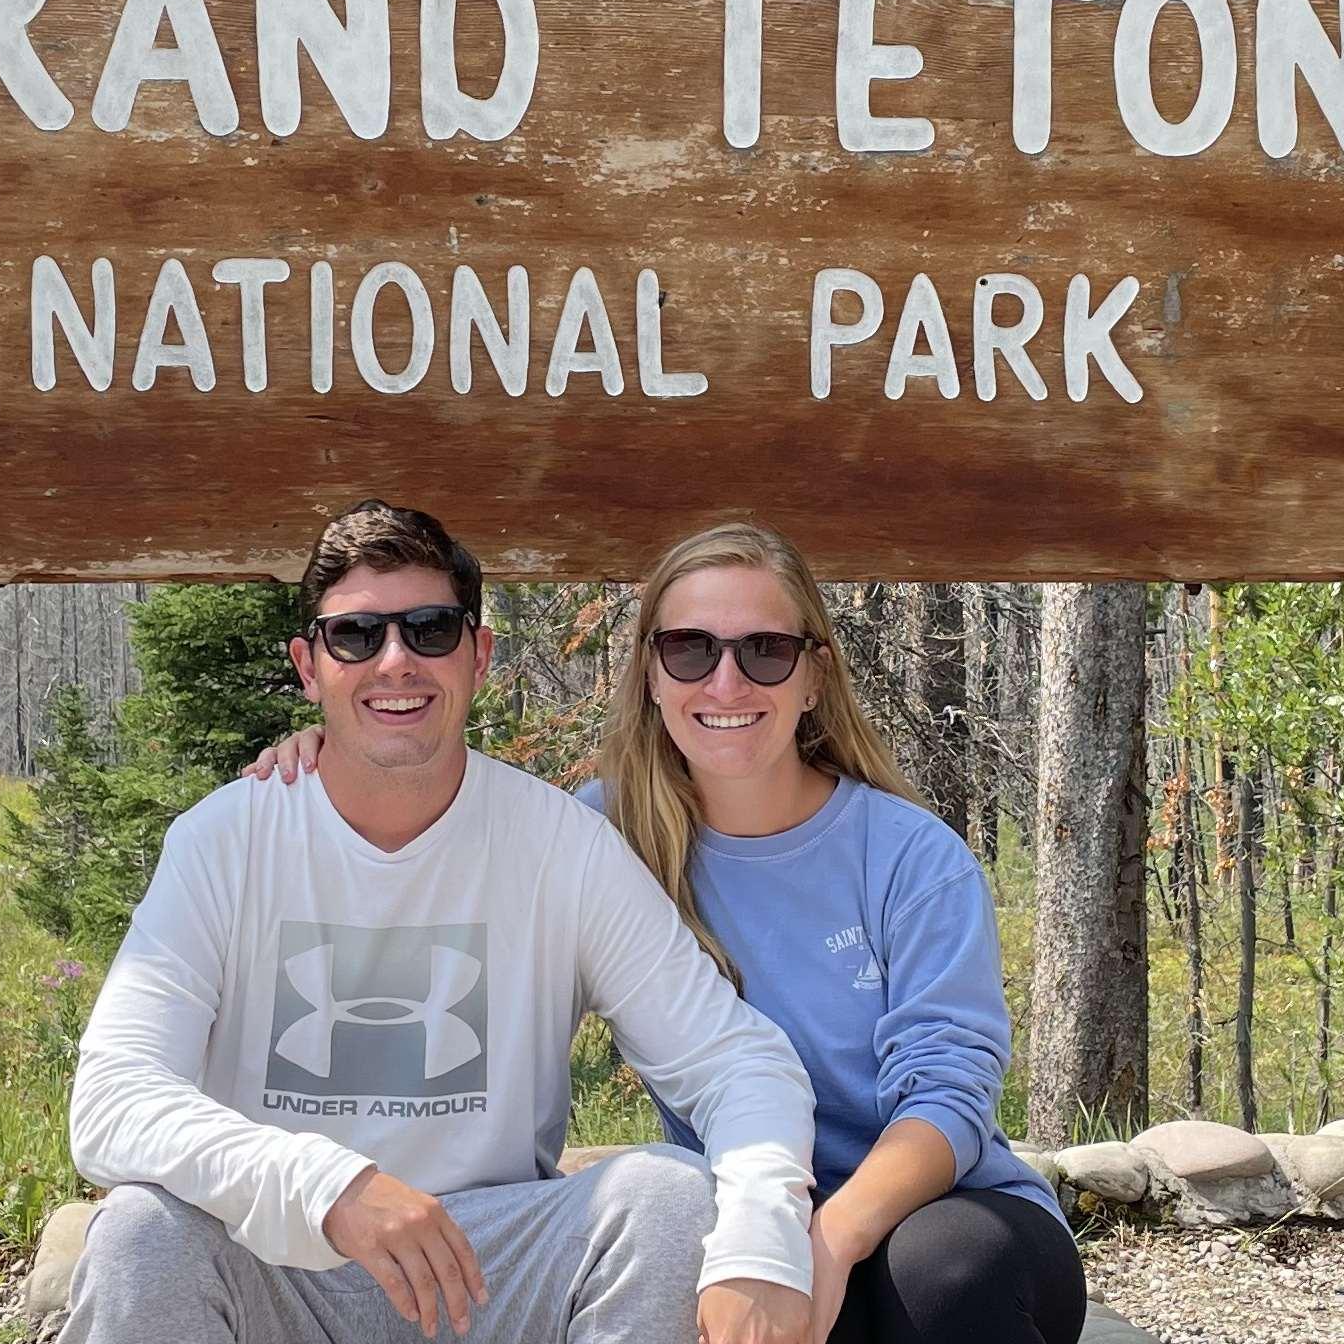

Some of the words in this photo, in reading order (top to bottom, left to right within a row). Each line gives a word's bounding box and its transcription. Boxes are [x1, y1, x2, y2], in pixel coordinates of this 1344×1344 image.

[30, 254, 709, 399] NATIONAL
[809, 267, 1144, 404] PARK
[826, 925, 864, 954] SAINT
[263, 1093, 358, 1116] UNDER
[366, 1096, 487, 1118] ARMOUR
